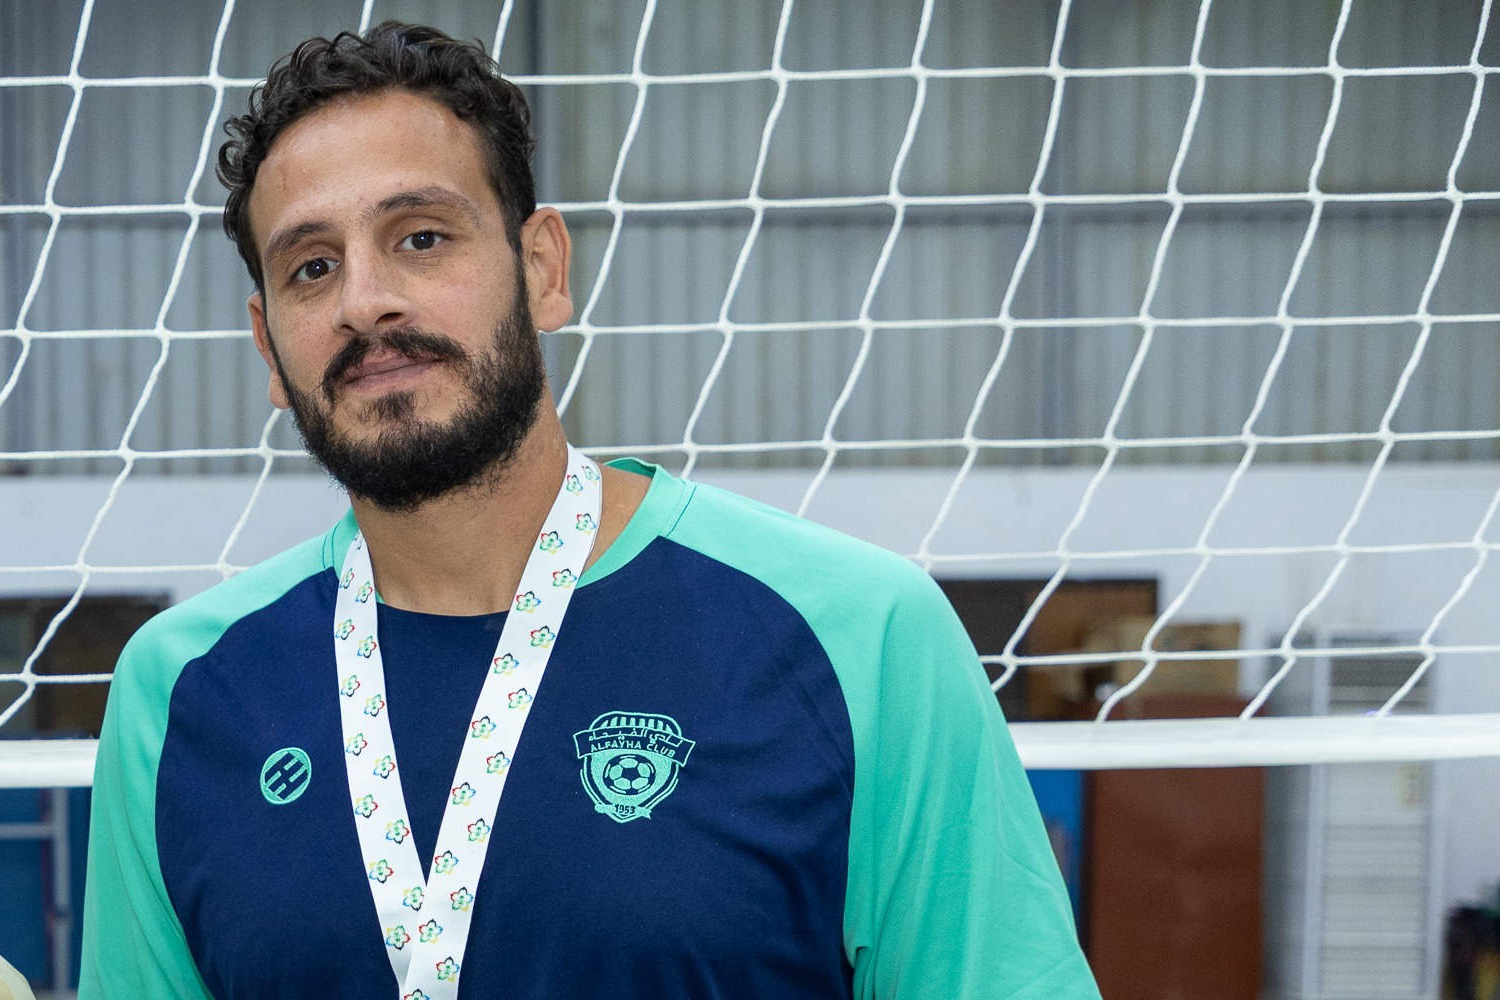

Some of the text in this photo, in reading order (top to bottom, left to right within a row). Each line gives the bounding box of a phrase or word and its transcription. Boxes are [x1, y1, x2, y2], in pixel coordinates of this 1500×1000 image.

[590, 741, 676, 758] ALFAYHA CLUB
[614, 804, 636, 814] 1953
